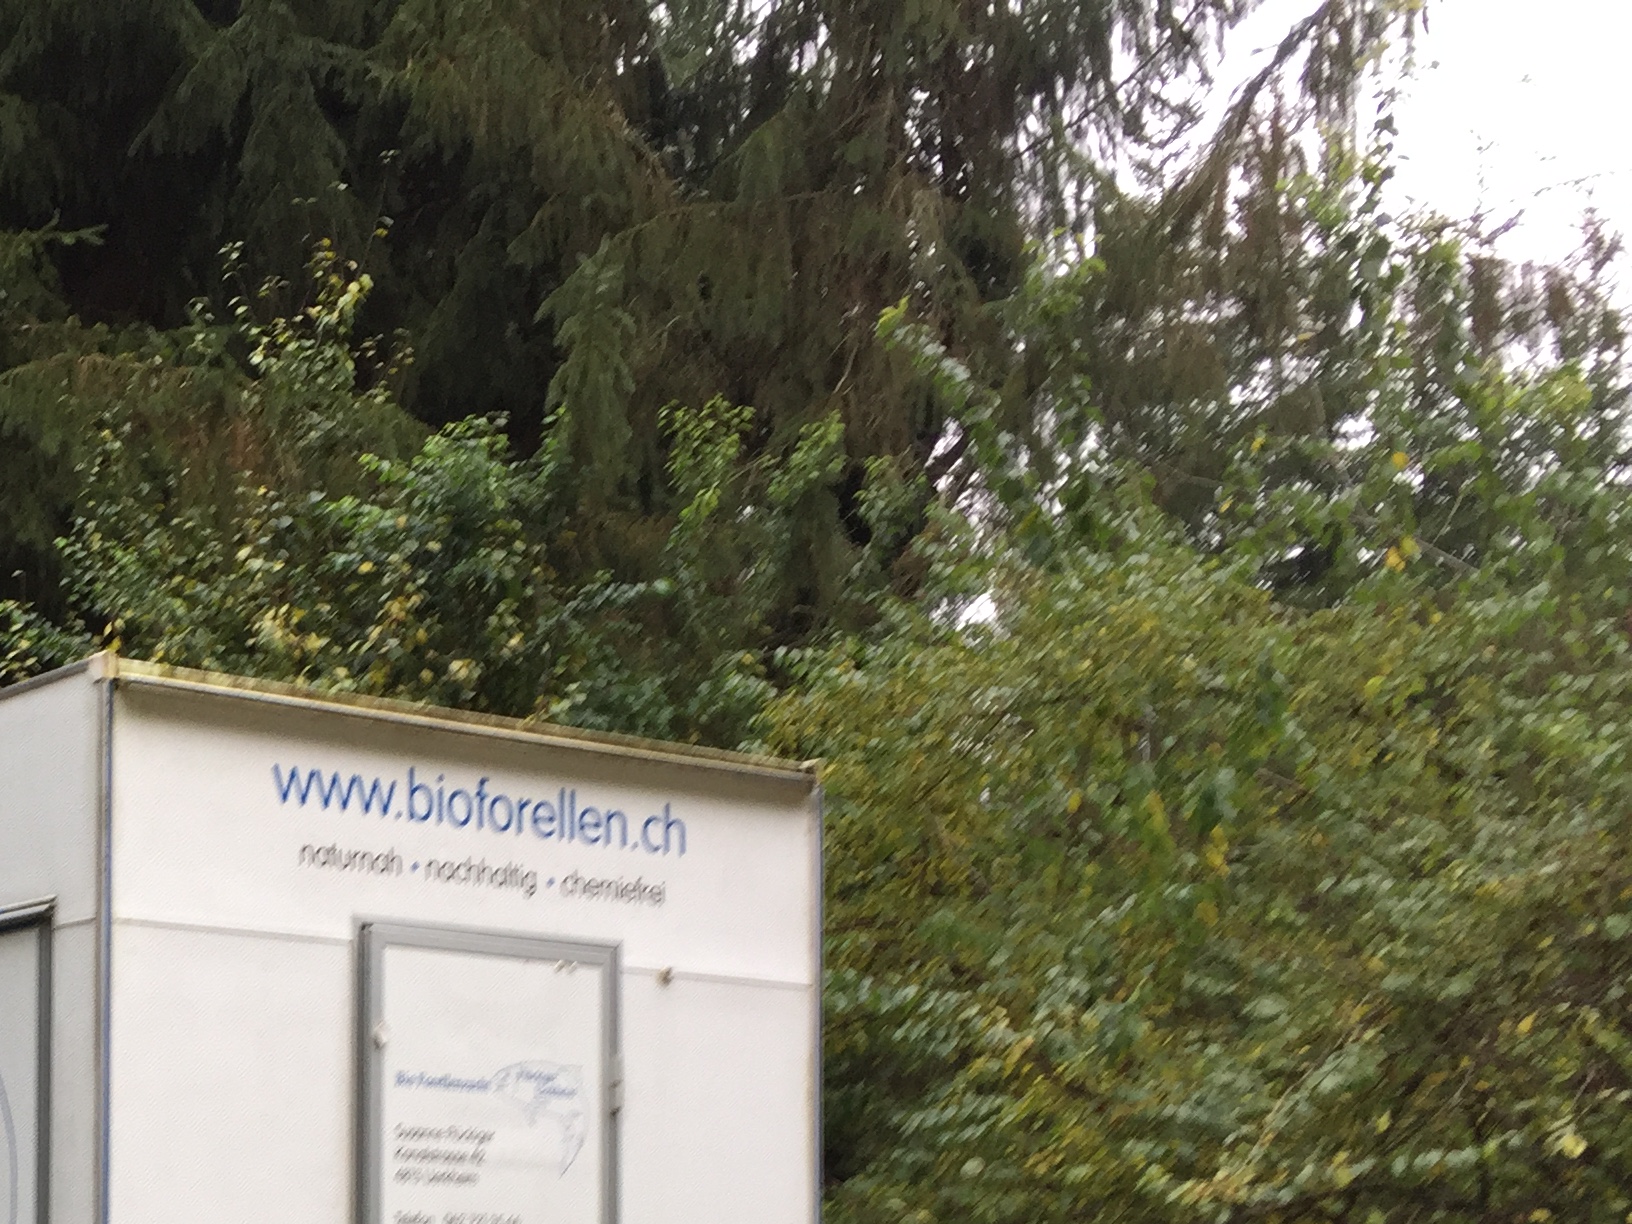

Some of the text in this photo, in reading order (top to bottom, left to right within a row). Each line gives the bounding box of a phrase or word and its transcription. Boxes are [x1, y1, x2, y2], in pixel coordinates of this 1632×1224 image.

[273, 762, 687, 857] www.bioforellen.ch
[299, 838, 667, 909] naturnah nachhaltig chemiefrei
